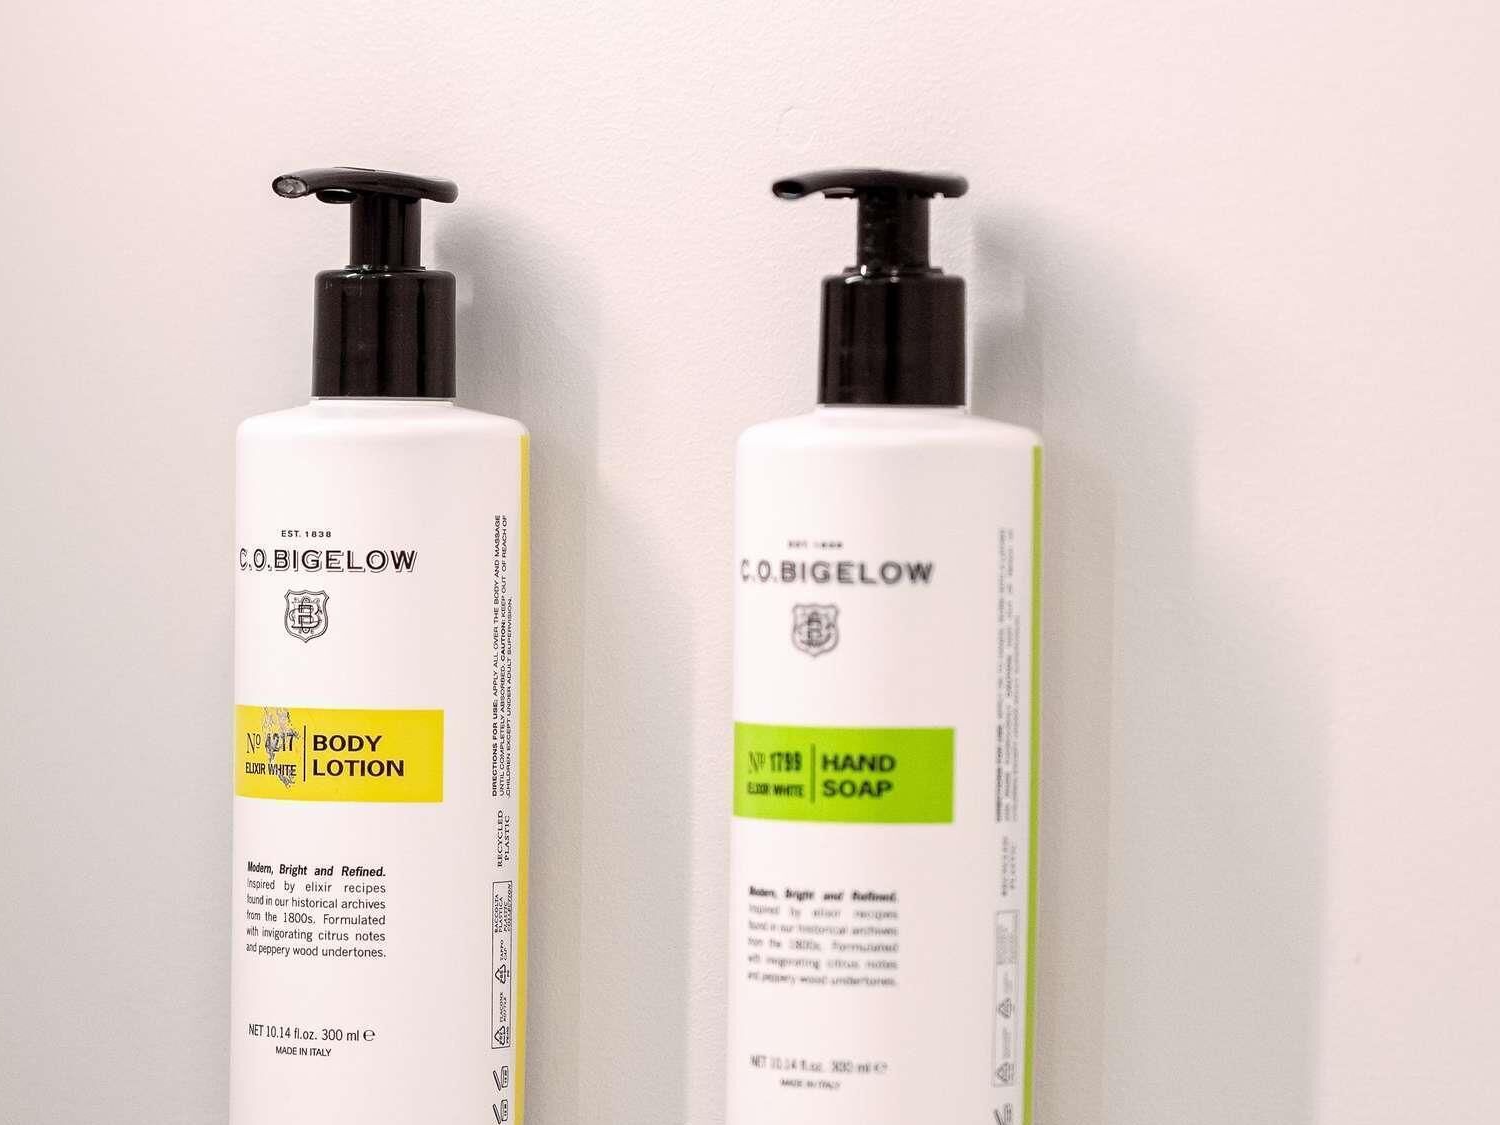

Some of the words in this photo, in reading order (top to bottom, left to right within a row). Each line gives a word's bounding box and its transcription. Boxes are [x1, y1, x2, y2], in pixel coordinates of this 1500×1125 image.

[281, 529, 302, 538] EST.
[239, 547, 418, 573] C.O.BIGELOW
[313, 735, 382, 752] BODY
[245, 762, 266, 775] ELIXIR
[268, 763, 297, 776] WHITE
[313, 759, 404, 777] LOTION
[822, 753, 897, 772] HAND
[823, 779, 894, 798] SOAP
[279, 863, 308, 878] Bright
[314, 865, 334, 877] and
[341, 865, 387, 877] Refined.
[247, 878, 276, 891] Inspired
[284, 880, 295, 893] by
[305, 881, 333, 893] elixir
[344, 882, 386, 896] recipes
[247, 894, 264, 906] found
[265, 896, 273, 906] in
[274, 898, 289, 907] our
[291, 897, 338, 909] historical
[340, 898, 386, 910] archives
[246, 909, 261, 921] from
[265, 911, 277, 922] the
[283, 912, 316, 924] 1800s.
[323, 913, 386, 926] Formulated
[246, 925, 259, 937] with
[262, 927, 313, 942] invigorating
[318, 929, 349, 941] citrus
[355, 931, 386, 942] notes
[246, 941, 257, 952] and
[258, 944, 291, 957] peppery
[293, 945, 318, 956] wood
[321, 946, 387, 958] undertones.
[248, 1023, 264, 1036] NET
[266, 1025, 291, 1039] 10.14
[321, 1029, 343, 1041] 300
[346, 1029, 360, 1042] ml
[275, 1046, 298, 1056] MADE
[299, 1047, 308, 1056] IN
[309, 1048, 332, 1057] ITALY
